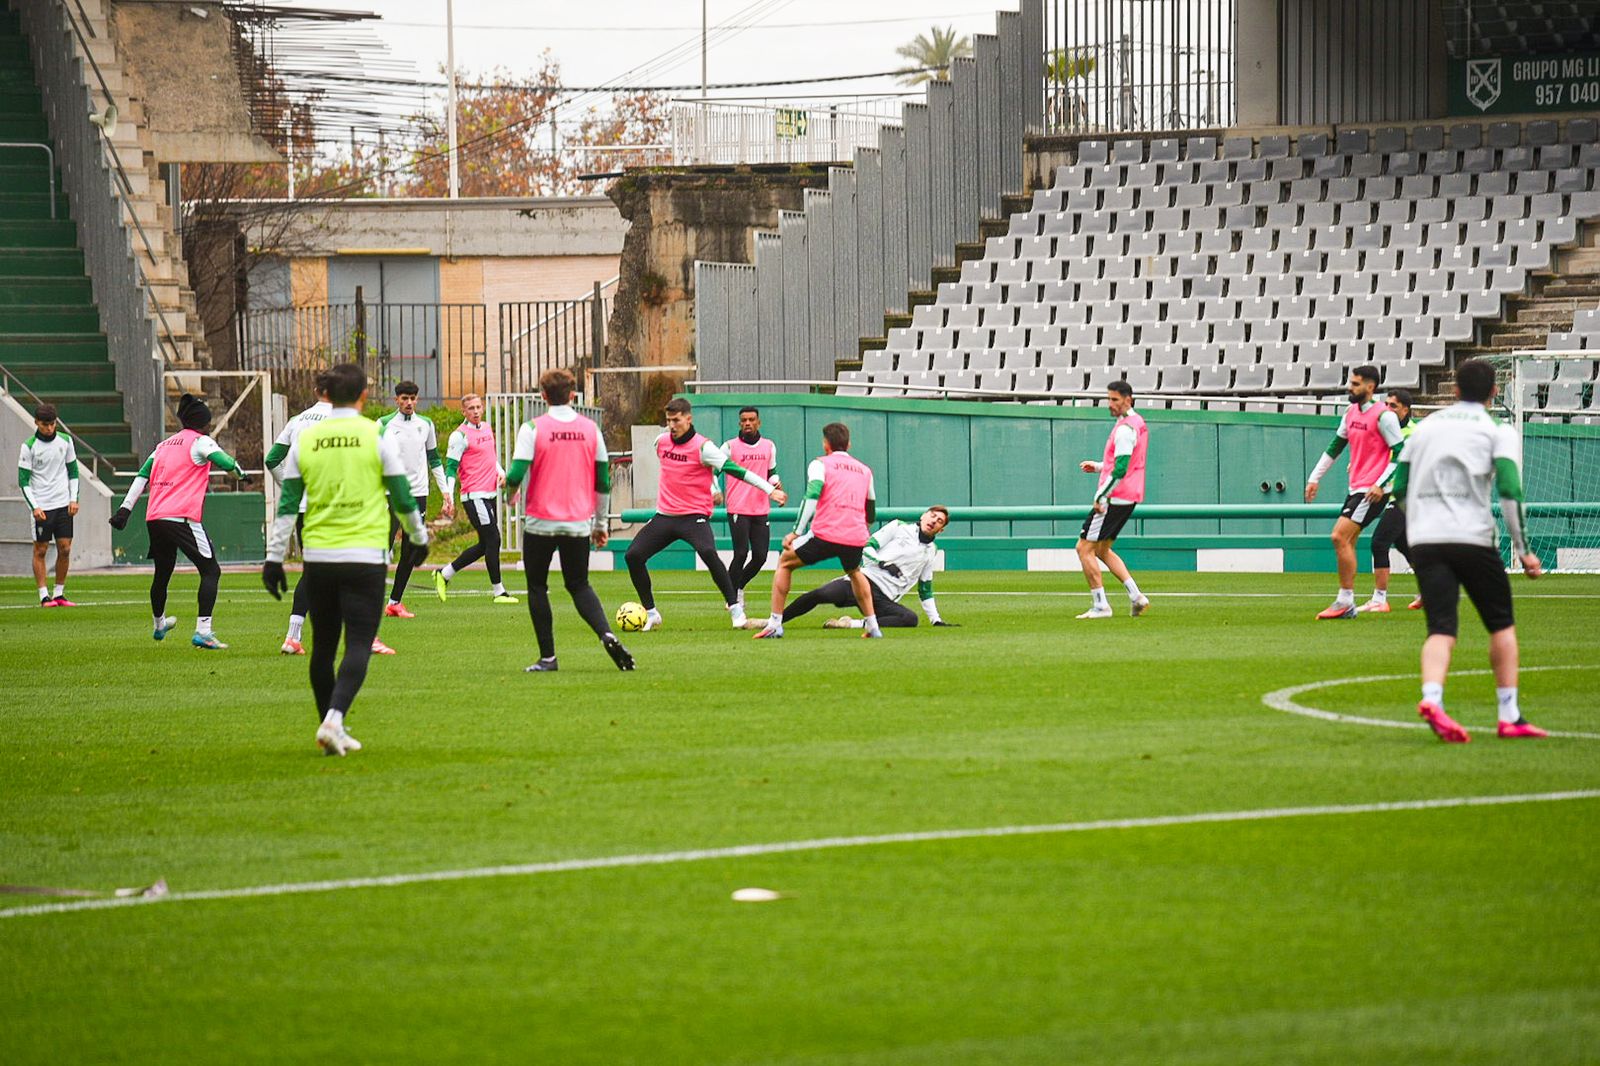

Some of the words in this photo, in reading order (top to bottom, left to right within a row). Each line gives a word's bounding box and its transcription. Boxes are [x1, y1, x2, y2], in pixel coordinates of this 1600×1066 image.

[1513, 59, 1558, 81] GRUPO
[1562, 58, 1584, 79] MG
[1535, 83, 1563, 106] 957
[1570, 81, 1600, 104] 040
